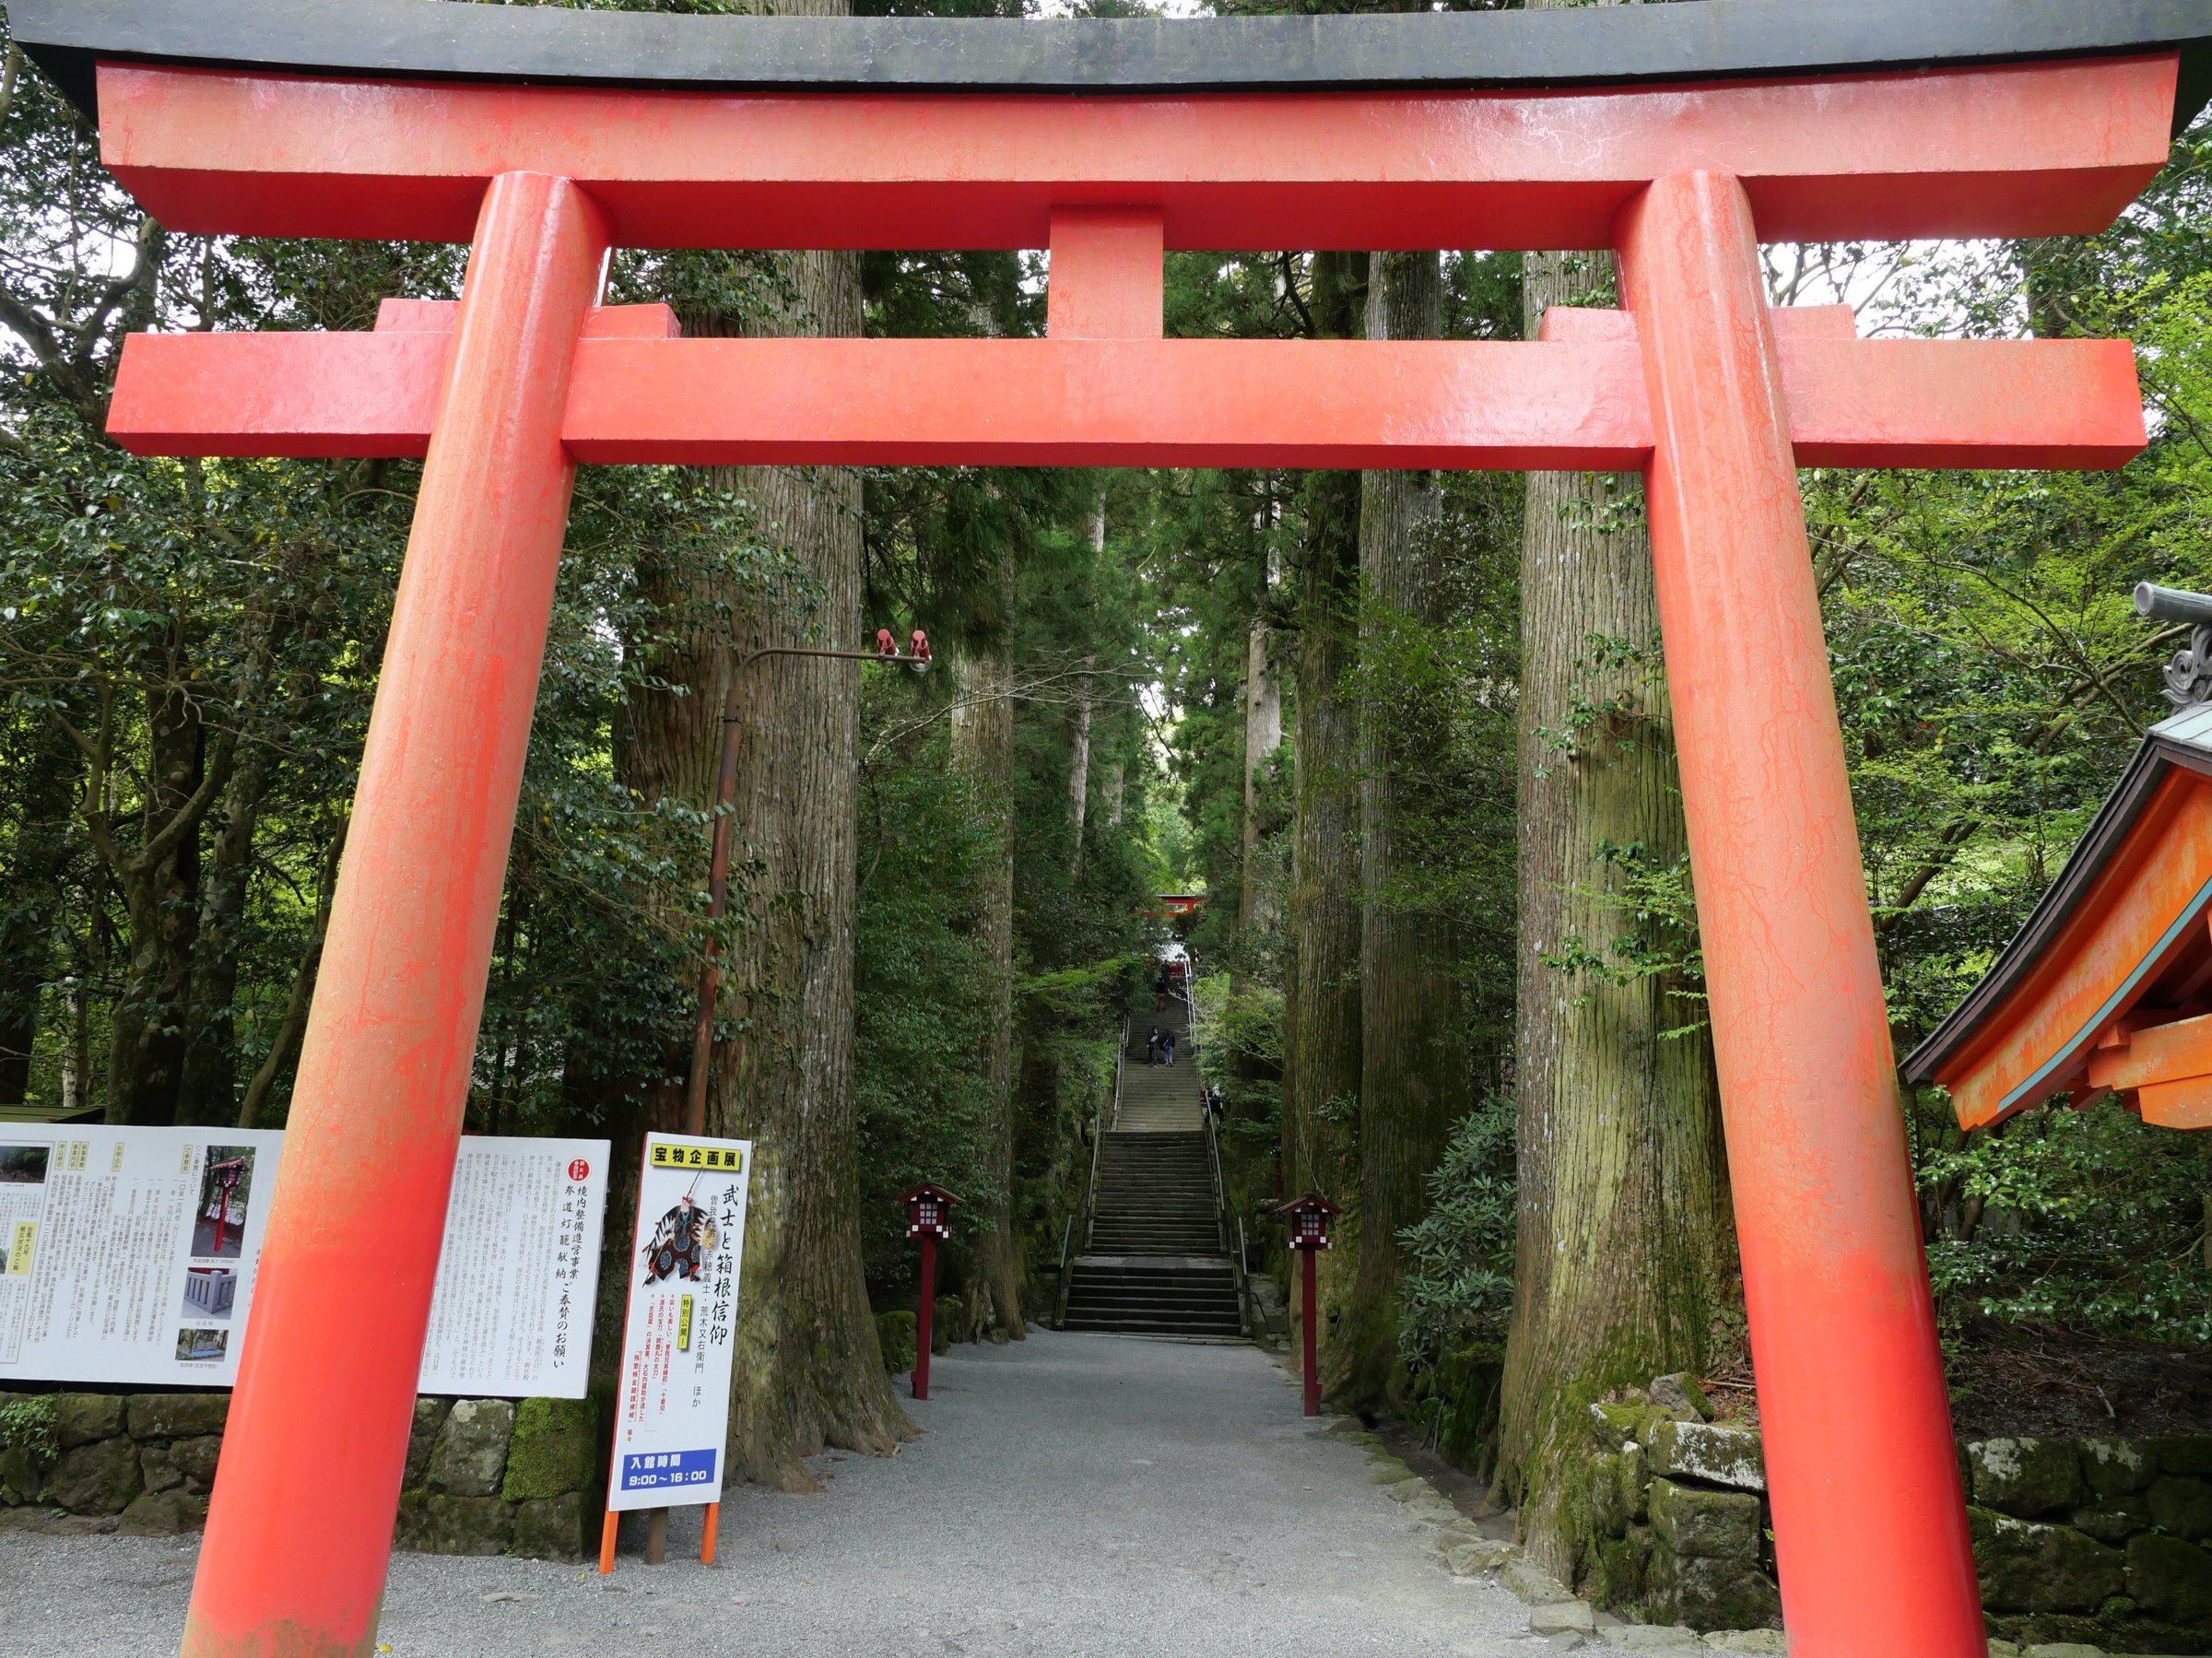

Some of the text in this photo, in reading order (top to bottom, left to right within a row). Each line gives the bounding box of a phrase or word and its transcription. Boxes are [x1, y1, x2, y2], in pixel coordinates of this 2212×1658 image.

[183, 1147, 191, 1171] ご奉賛金
[654, 1147, 735, 1167] 宝物企画展
[555, 1185, 575, 1279] 参道灯籠献納
[569, 1185, 588, 1279] 境内整備造営事業
[709, 1184, 739, 1346] 武士と箱根信仰
[553, 1281, 572, 1369] ご奉賛のお願い
[692, 1386, 702, 1408] ほか
[630, 1453, 681, 1470] 入館時間
